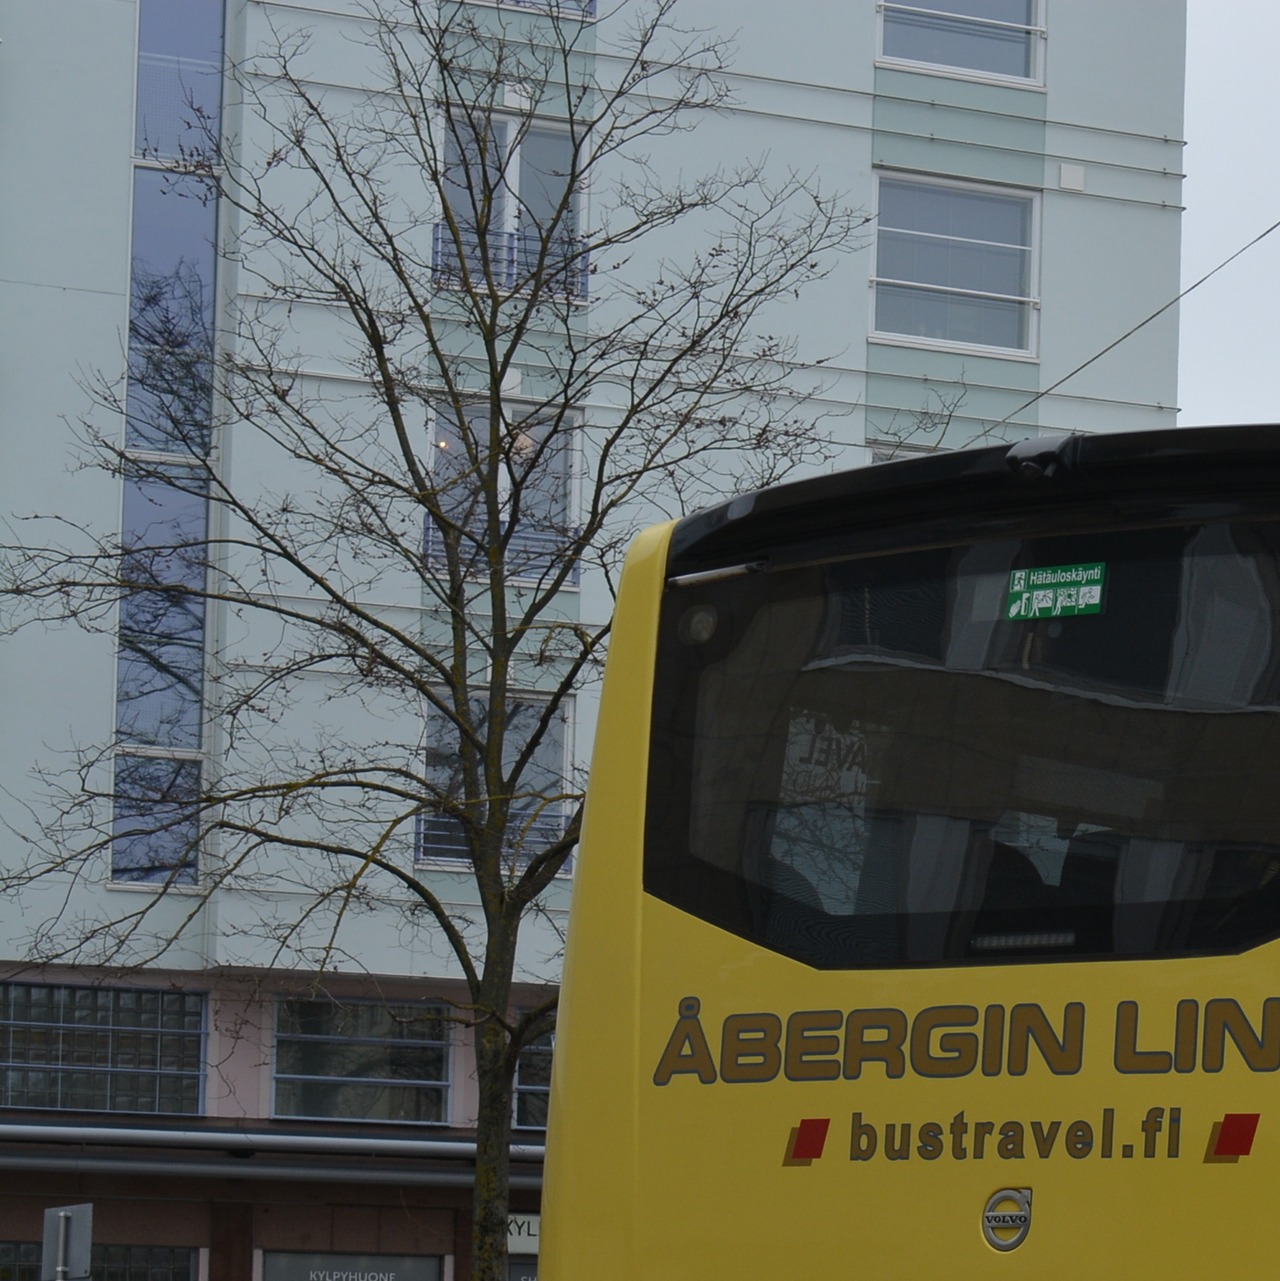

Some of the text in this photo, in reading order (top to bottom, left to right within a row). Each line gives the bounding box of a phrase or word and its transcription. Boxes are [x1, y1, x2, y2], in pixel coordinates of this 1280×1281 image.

[1029, 566, 1102, 585] Hätäuloskäynti
[653, 996, 1086, 1087] ÅBERGIN
[849, 1107, 1183, 1163] bustravel.fi
[984, 1215, 1028, 1224] VOLVO
